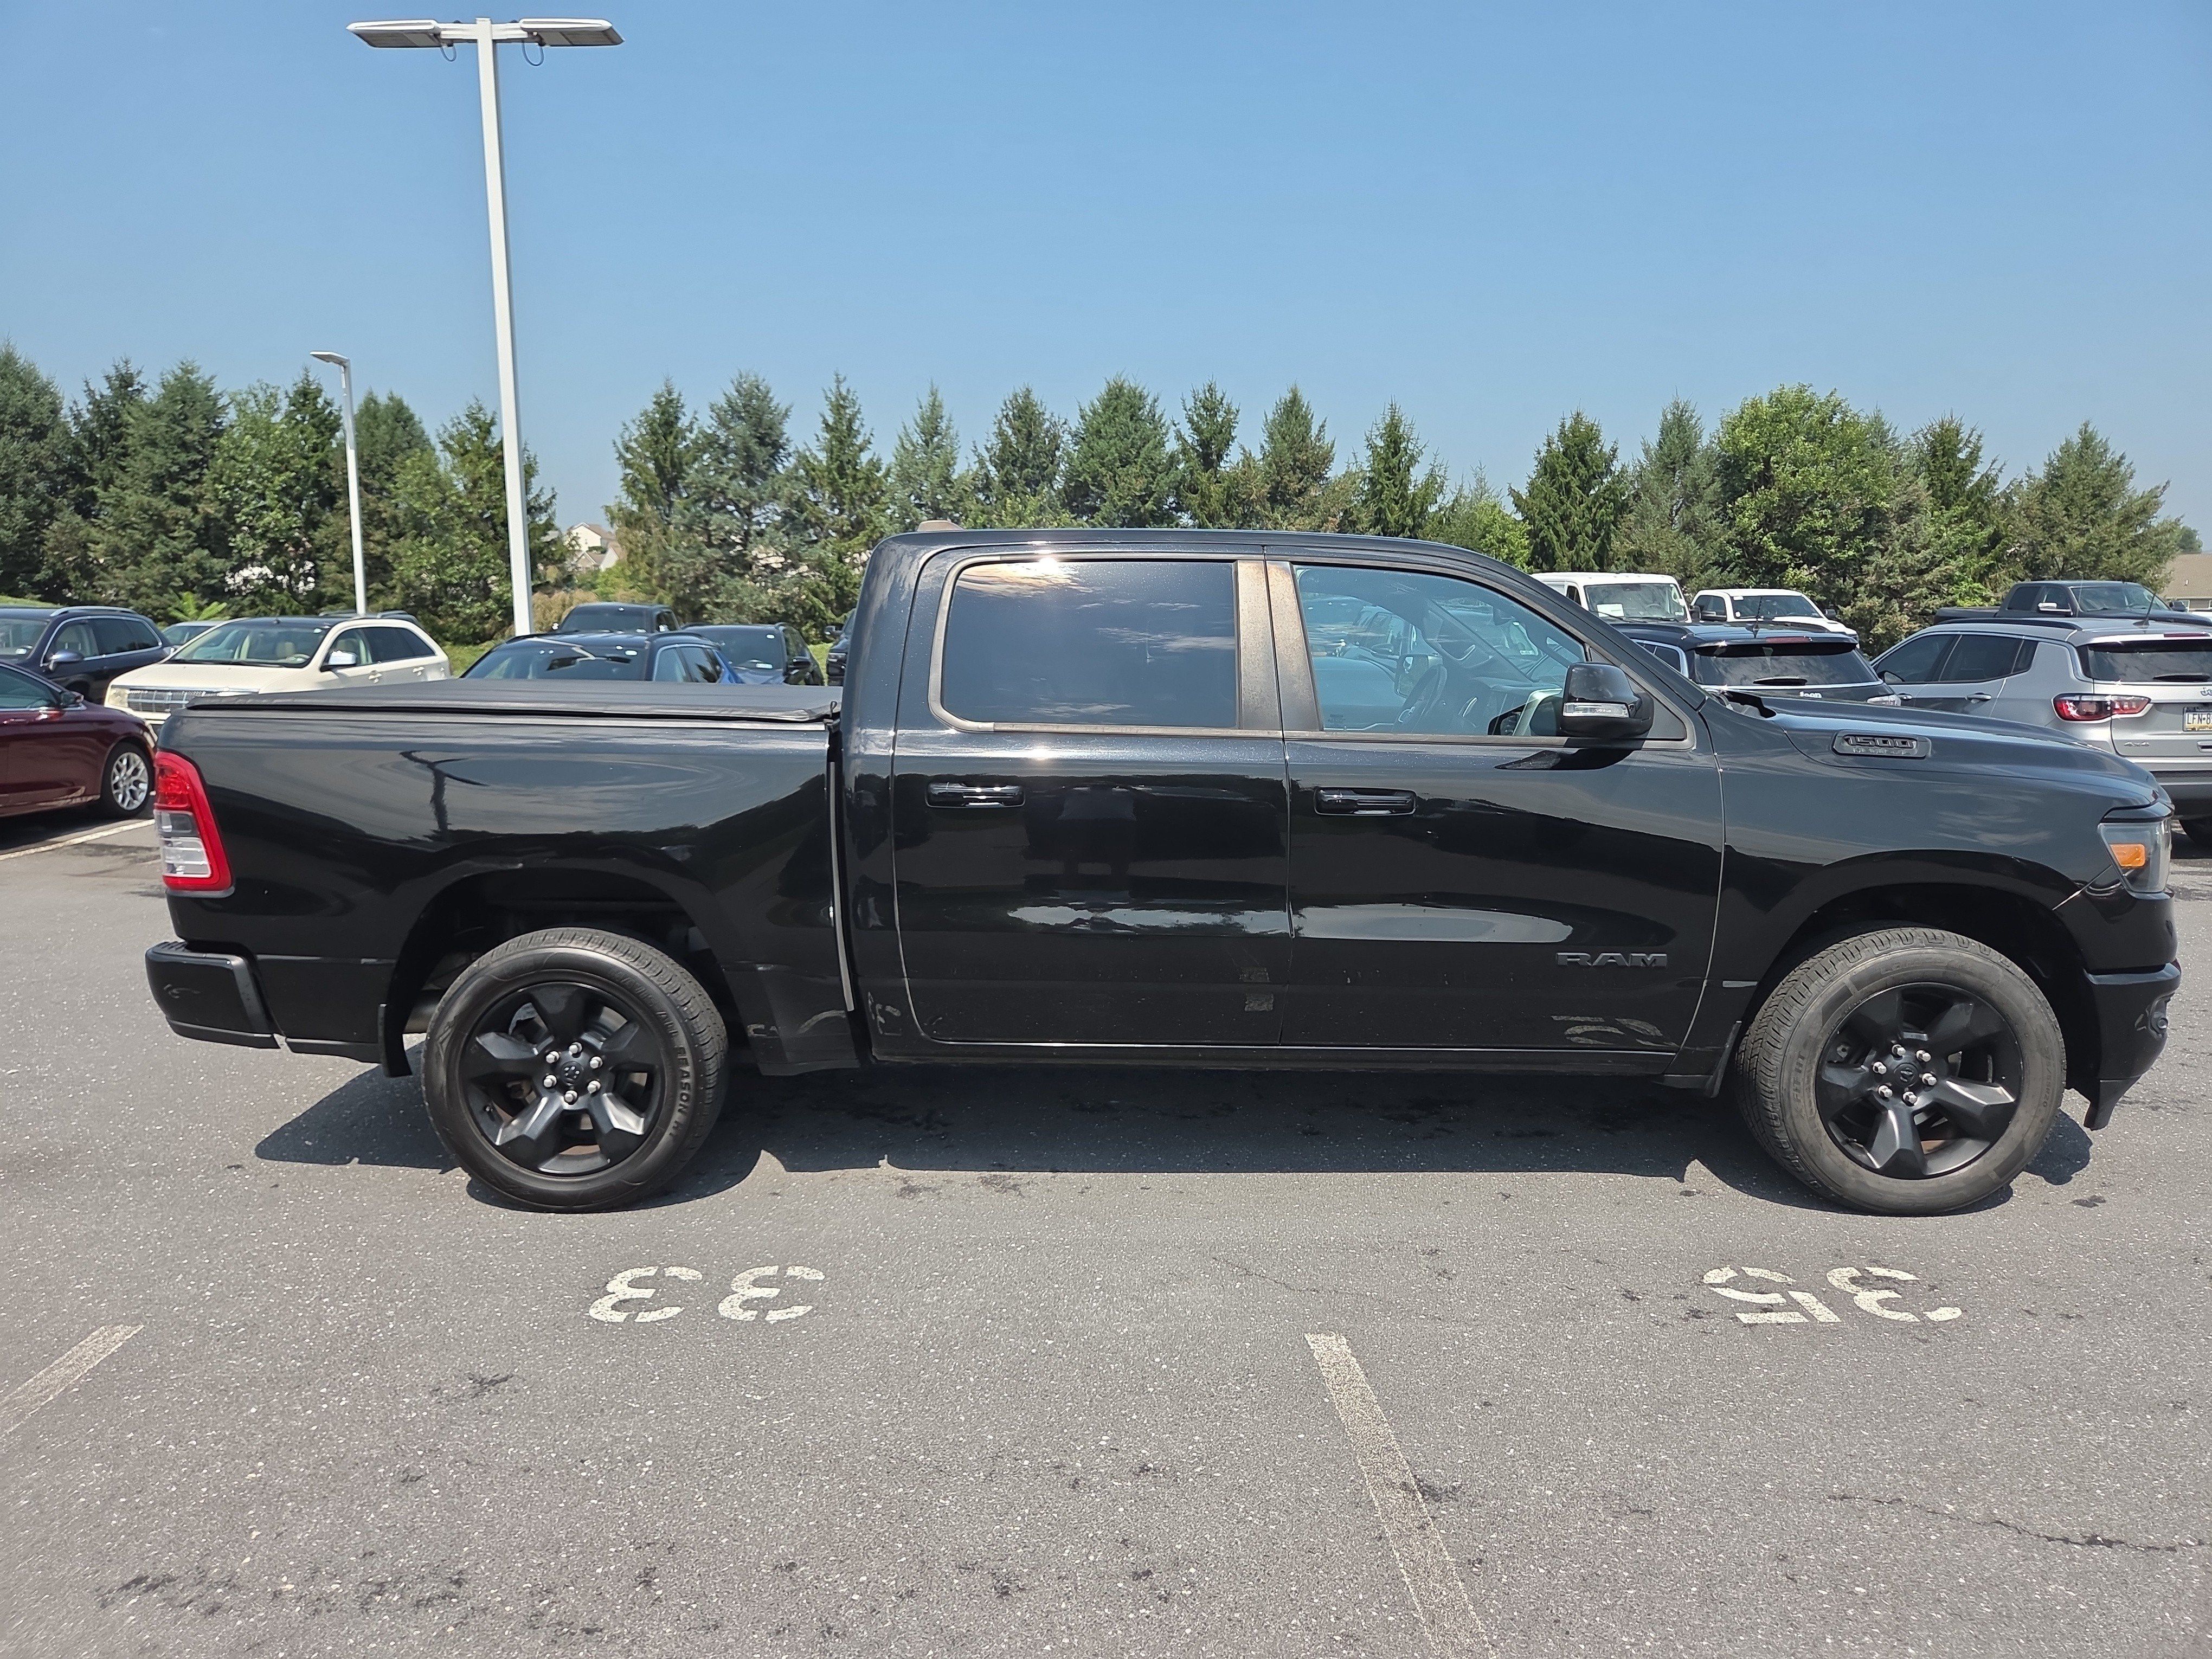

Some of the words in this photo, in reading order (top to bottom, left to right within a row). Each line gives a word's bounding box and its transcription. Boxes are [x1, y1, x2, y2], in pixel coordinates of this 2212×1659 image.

[1843, 735, 1918, 749] 1500
[1556, 953, 1668, 967] RAM
[674, 1046, 691, 1114] SEASON
